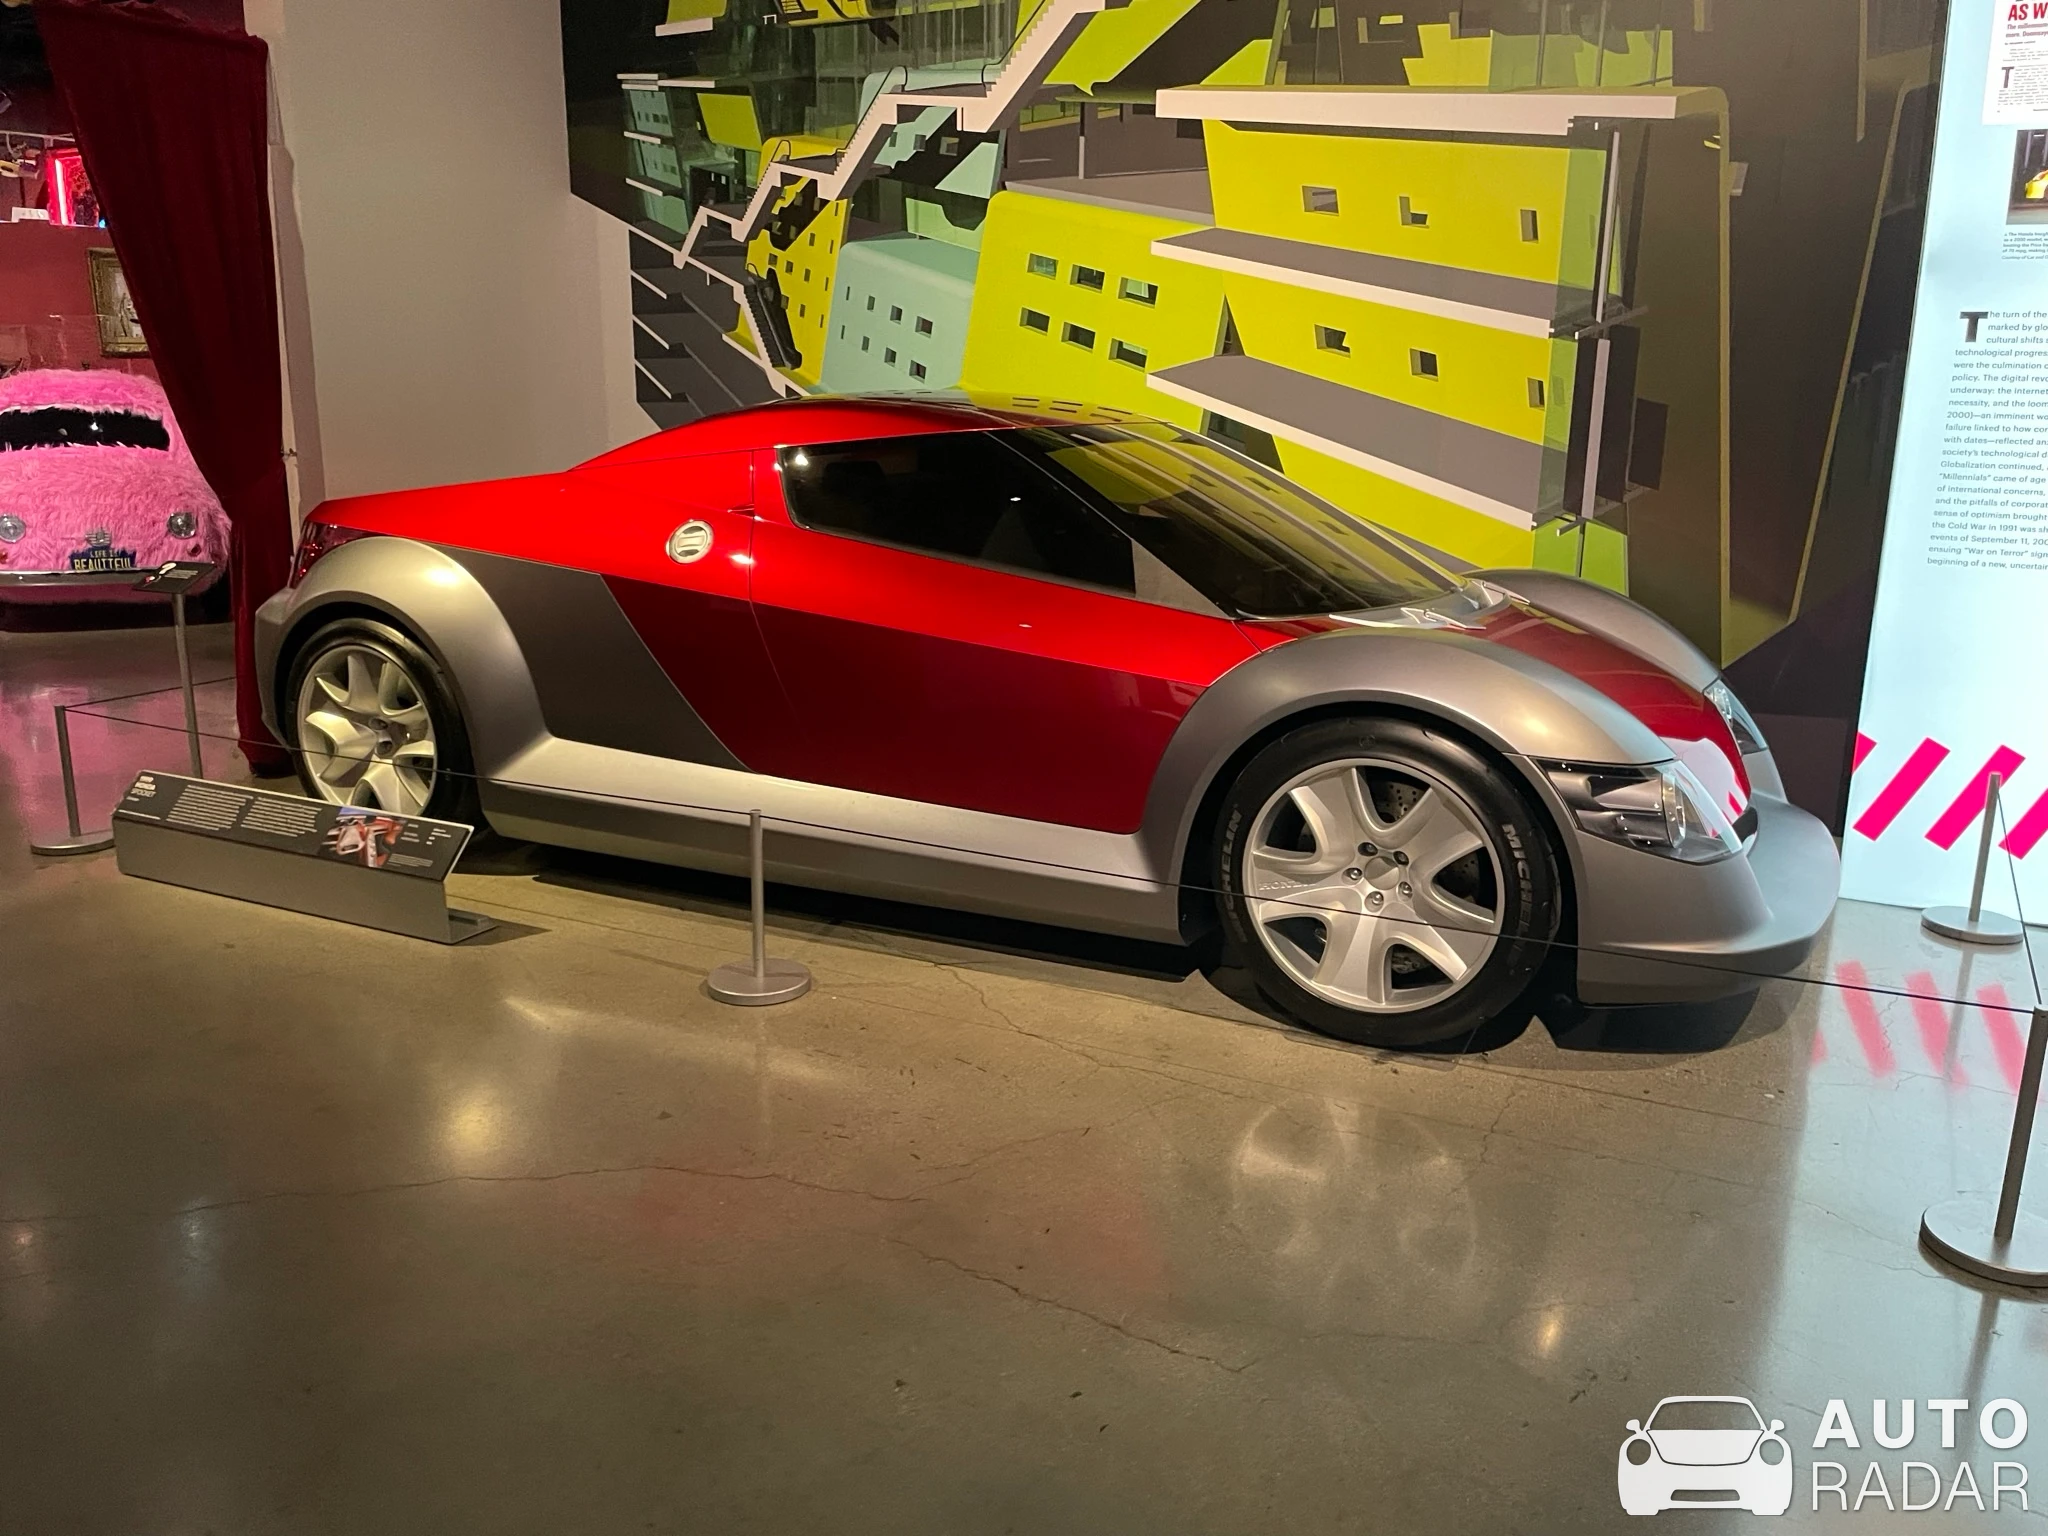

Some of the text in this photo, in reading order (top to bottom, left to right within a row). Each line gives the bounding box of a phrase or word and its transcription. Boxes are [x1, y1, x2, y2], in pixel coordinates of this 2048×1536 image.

[2008, 4, 2029, 21] AS
[1955, 349, 2012, 357] technological
[1952, 374, 1980, 382] policy.
[2001, 375, 2029, 383] digital
[1950, 387, 1995, 395] underway:
[1974, 424, 2000, 432] linked
[1981, 450, 2039, 458] technological
[1940, 461, 2044, 471] Globalization continued,
[1948, 486, 2001, 494] international
[1969, 499, 1998, 507] pitfalls
[2013, 513, 2047, 521] brought
[1971, 535, 2018, 544] September
[1929, 546, 1961, 555] ensuing
[1927, 557, 1968, 567] beginning
